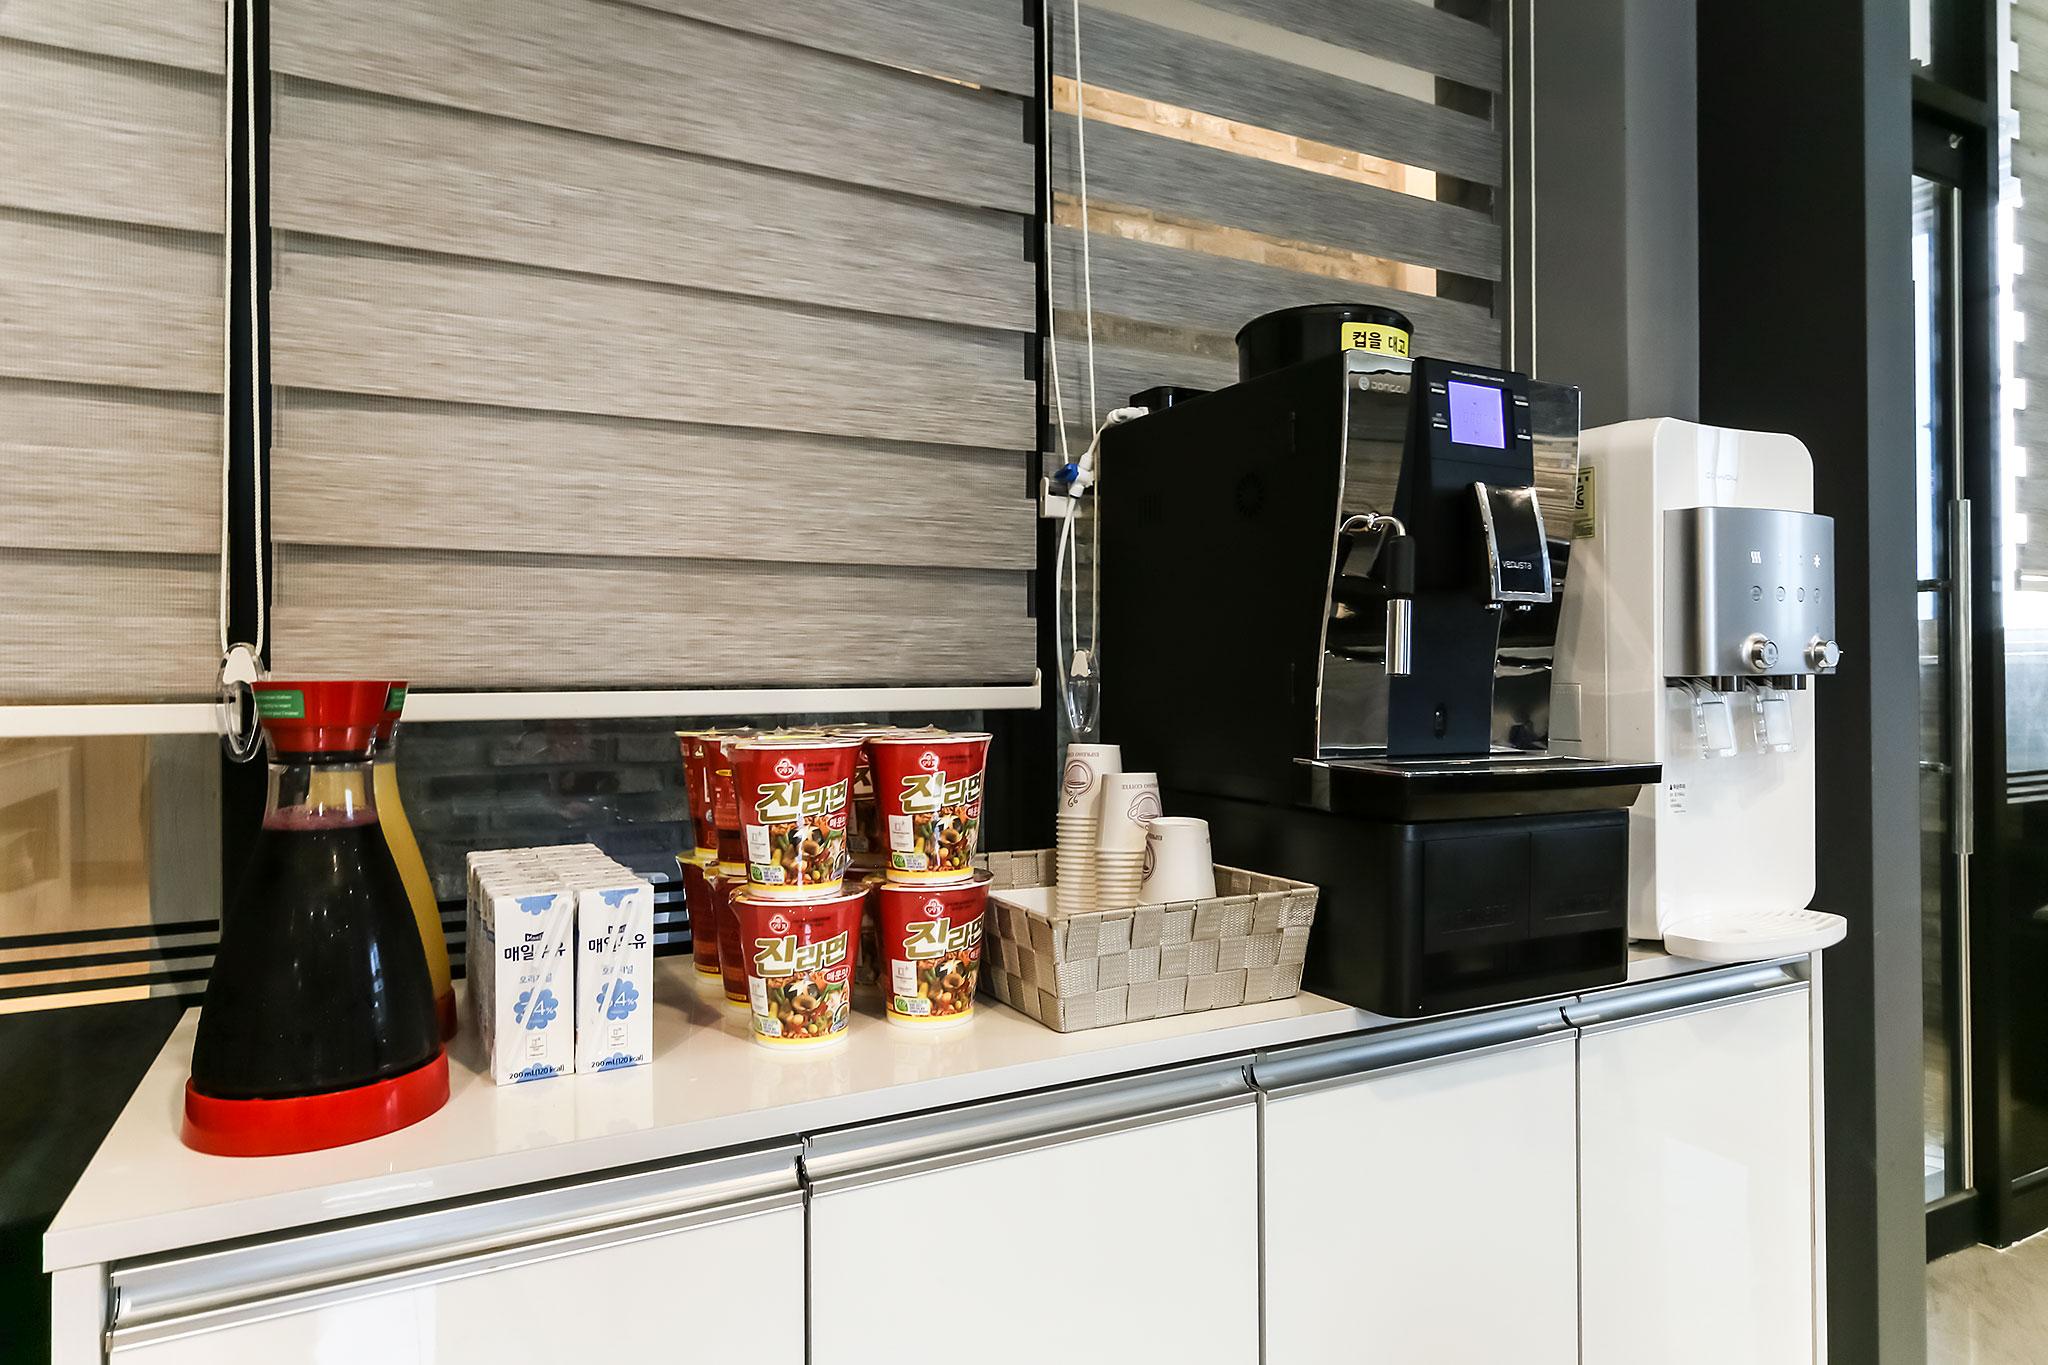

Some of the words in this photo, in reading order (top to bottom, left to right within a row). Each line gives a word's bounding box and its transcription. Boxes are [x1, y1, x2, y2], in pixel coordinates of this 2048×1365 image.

[1353, 331, 1382, 349] 컵을
[1388, 336, 1405, 354] 대고
[756, 778, 848, 824] 진라면
[899, 770, 983, 814] 진라면
[754, 930, 847, 978] 진라면
[903, 912, 984, 960] 진라면
[509, 1071, 524, 1080] 200
[591, 1060, 605, 1068] 200
